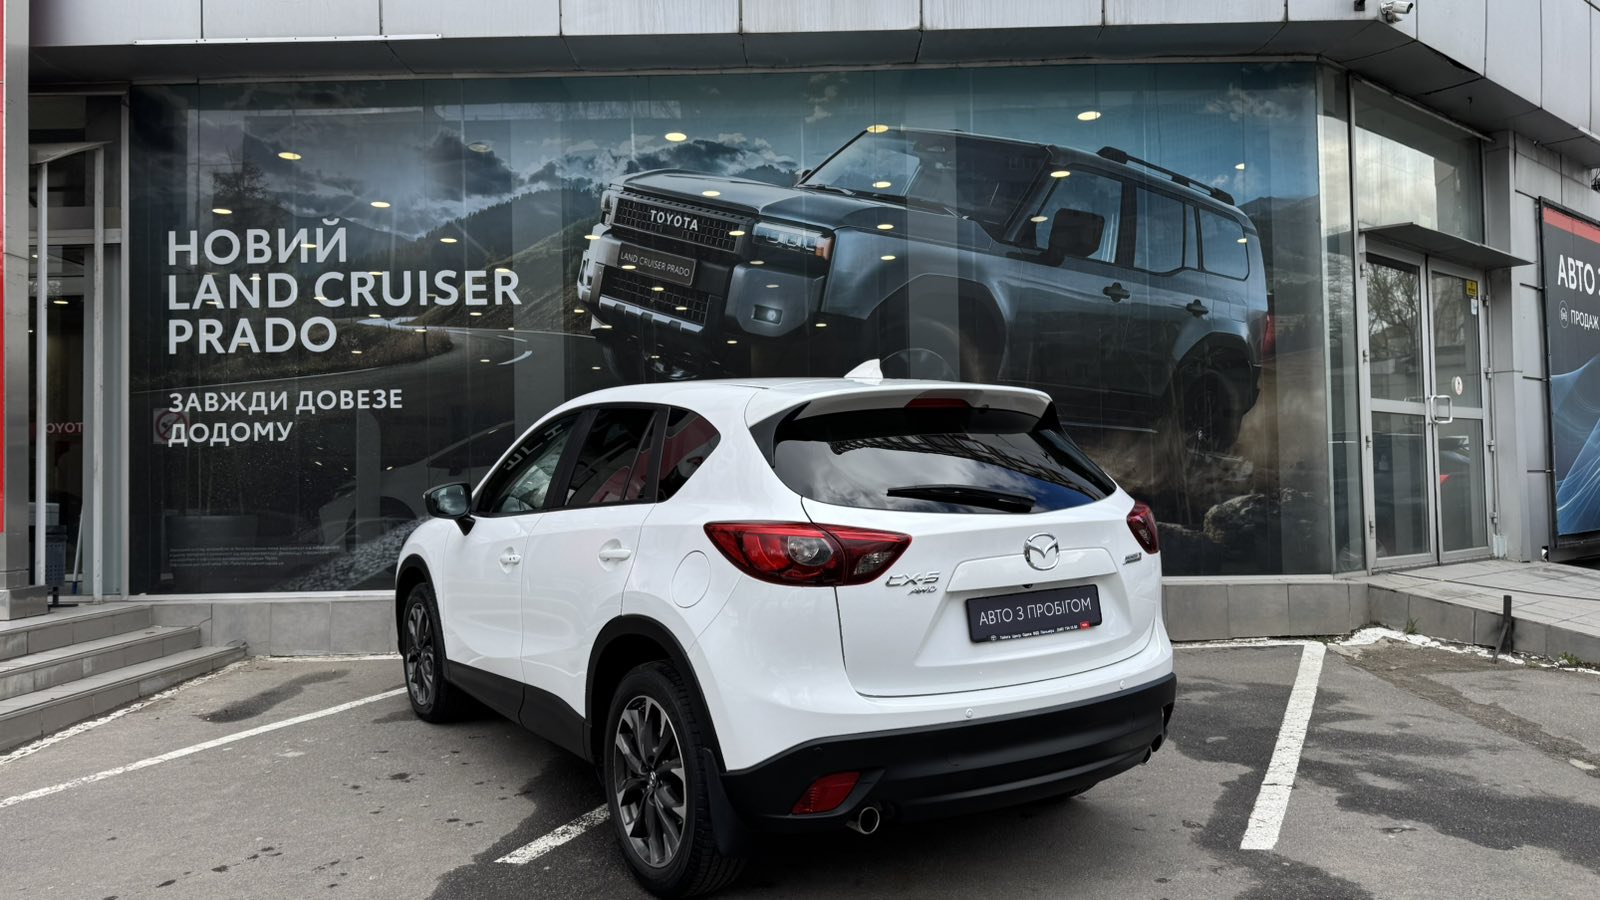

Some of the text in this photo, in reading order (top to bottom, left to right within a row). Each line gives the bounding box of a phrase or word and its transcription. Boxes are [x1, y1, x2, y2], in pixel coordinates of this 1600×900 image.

[650, 210, 698, 231] TOYOTA
[169, 218, 347, 266] НОВИЙ
[620, 251, 690, 277] LAND CRUISER PRADO
[1557, 254, 1595, 295] АВТО
[168, 268, 522, 310] LAND CRUISER
[1570, 309, 1600, 331] ПРОДАЖ
[169, 316, 337, 355] PRADO
[168, 389, 403, 416] ЗАВЖДИ ДОВЕЗЕ
[46, 422, 83, 433] OYOT
[168, 421, 294, 448] ДОДОМУ
[885, 571, 940, 587] CX-5
[979, 597, 1093, 626] АВТО З ПРОБІГОМ
